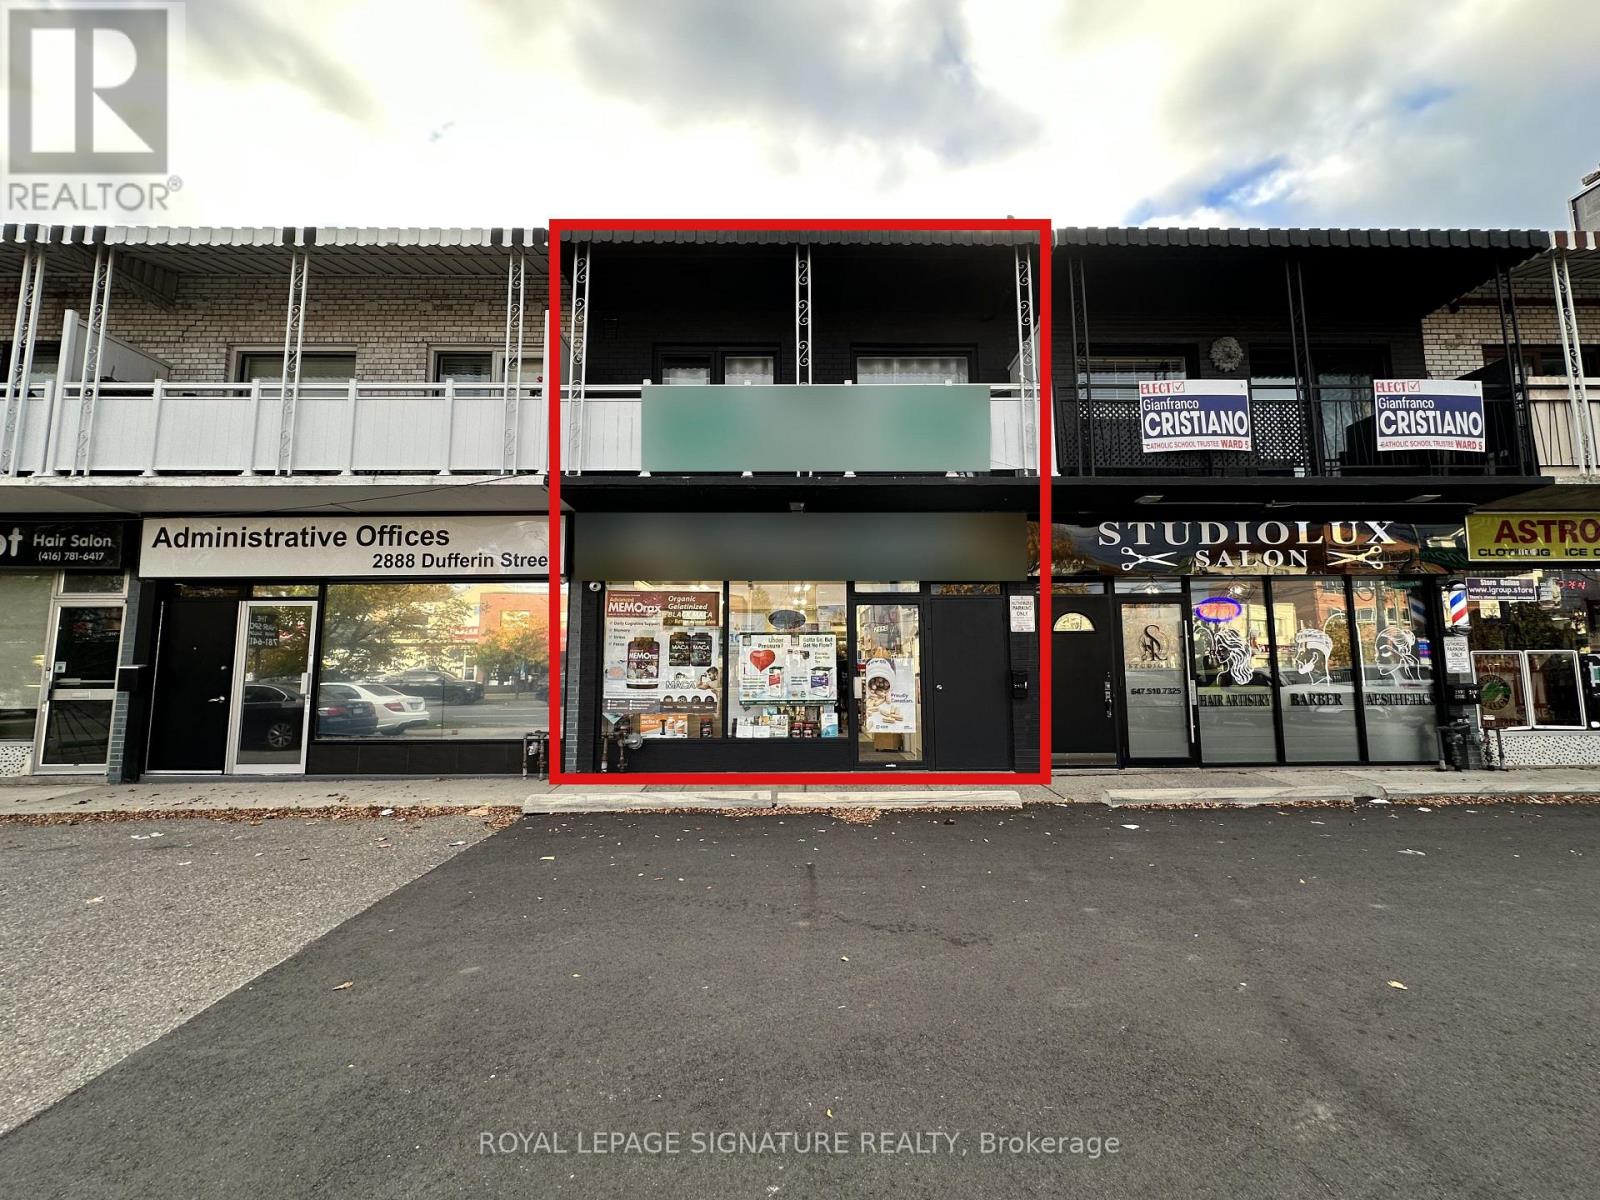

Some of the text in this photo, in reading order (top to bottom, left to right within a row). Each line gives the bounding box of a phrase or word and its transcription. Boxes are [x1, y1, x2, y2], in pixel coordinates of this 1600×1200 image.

[1140, 382, 1171, 394] ELECT
[1375, 381, 1406, 392] ELECT
[1143, 397, 1199, 411] Gianfranco
[1378, 396, 1435, 409] Gianfranco
[1145, 410, 1248, 436] CRISTIANO
[1379, 410, 1482, 435] CRISTIANO
[1146, 439, 1249, 450] CATHOLIC SCHOOL TRUSTEE WARD 5
[1381, 439, 1483, 450] CATHOLIC SCHOOL TRUSTEE WARD 5
[152, 525, 450, 548] Administrative Offices
[1098, 521, 1397, 545] STUDIOLUX
[1494, 518, 1600, 544] ASTRO
[33, 534, 112, 547] Hair Salon
[38, 551, 104, 561] (416) 781-6417
[1195, 550, 1308, 567] SALON
[1478, 547, 1550, 557] CLOTHING
[1565, 547, 1587, 557] ICE
[372, 552, 549, 568] 2888 Dufferin Stree
[668, 595, 696, 603] Organic
[608, 602, 661, 613] MEMOrax
[1199, 694, 1223, 707] HAIR
[1289, 693, 1343, 706] BARBER
[1365, 693, 1435, 706] AESTHETICS
